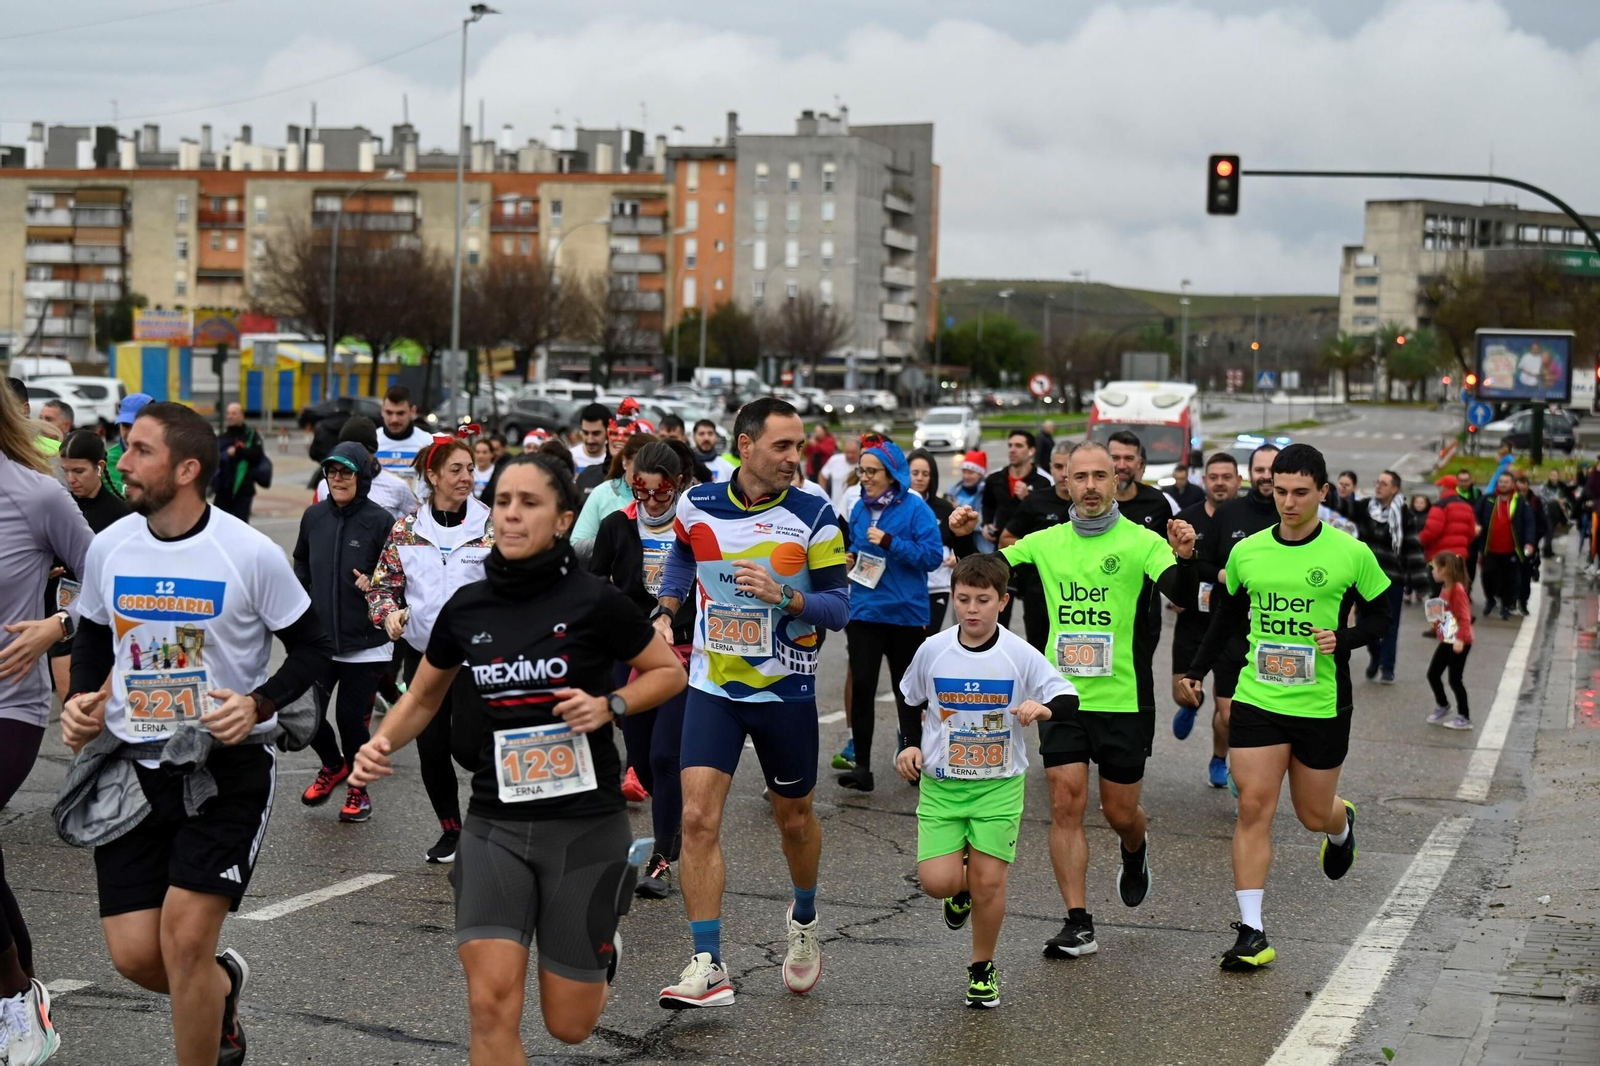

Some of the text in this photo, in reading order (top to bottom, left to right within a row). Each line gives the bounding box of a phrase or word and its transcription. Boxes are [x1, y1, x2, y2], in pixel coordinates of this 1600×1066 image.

[660, 542, 673, 550] 12
[644, 565, 665, 584] 7
[155, 581, 175, 594] 12
[1059, 582, 1109, 602] Uber
[118, 594, 214, 616] CORDOBARIA
[1257, 592, 1315, 613] Uber
[1058, 605, 1112, 626] Eats
[1260, 614, 1314, 637] Eats
[708, 616, 760, 645] 240
[1064, 645, 1095, 666] 50
[1266, 655, 1297, 677] 55
[964, 682, 980, 692] 12
[128, 688, 196, 719] 221
[937, 692, 1008, 705] CORDOBARIA
[503, 744, 576, 783] 129
[949, 743, 1004, 767] 238
